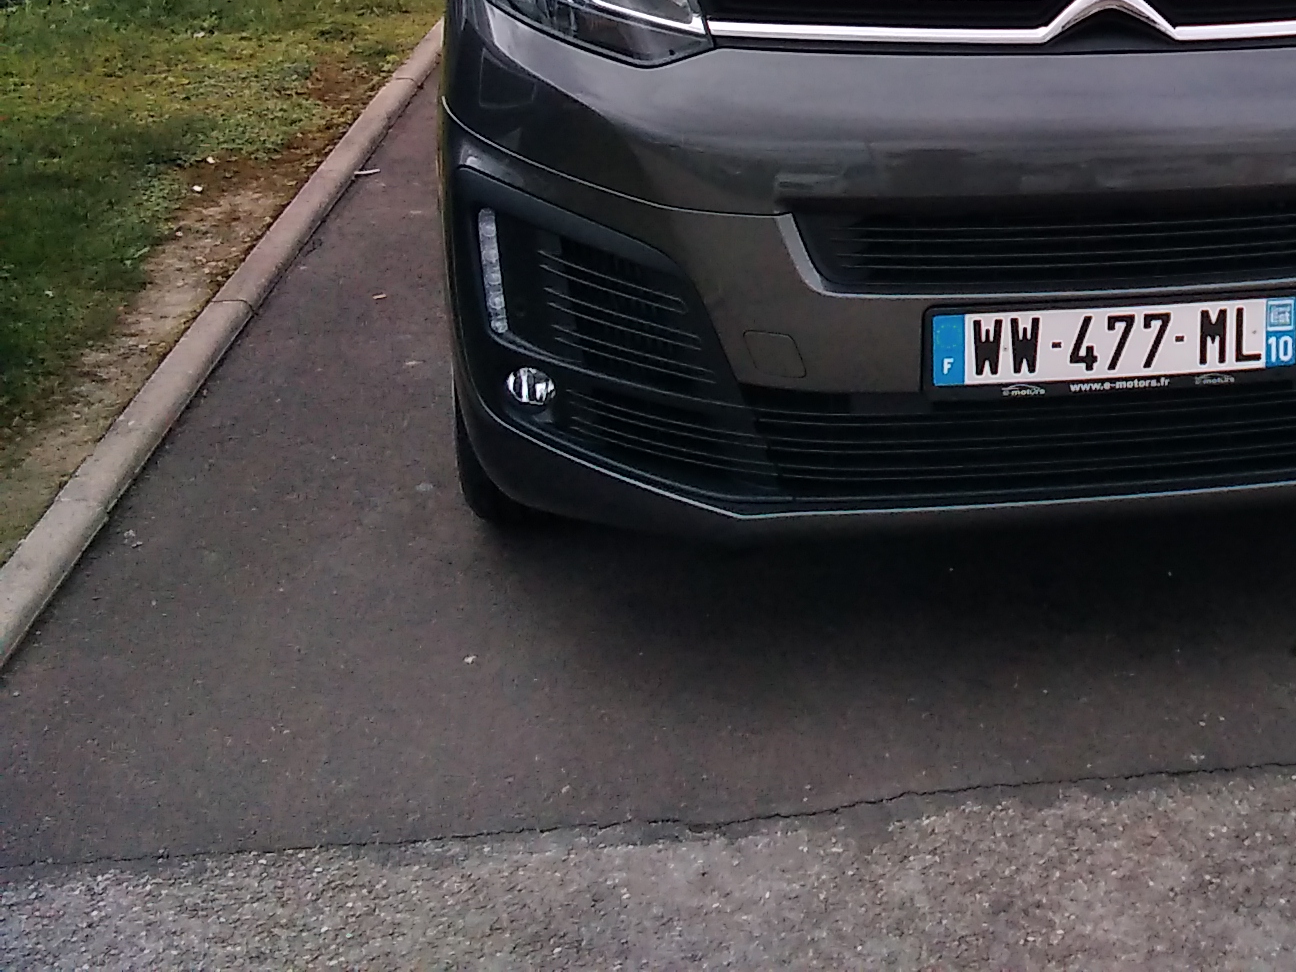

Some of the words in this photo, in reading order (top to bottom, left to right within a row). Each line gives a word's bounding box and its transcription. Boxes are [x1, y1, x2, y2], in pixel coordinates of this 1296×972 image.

[1268, 335, 1293, 363] 10
[943, 358, 954, 375] F
[1069, 376, 1171, 393] www.e-motors.fr
